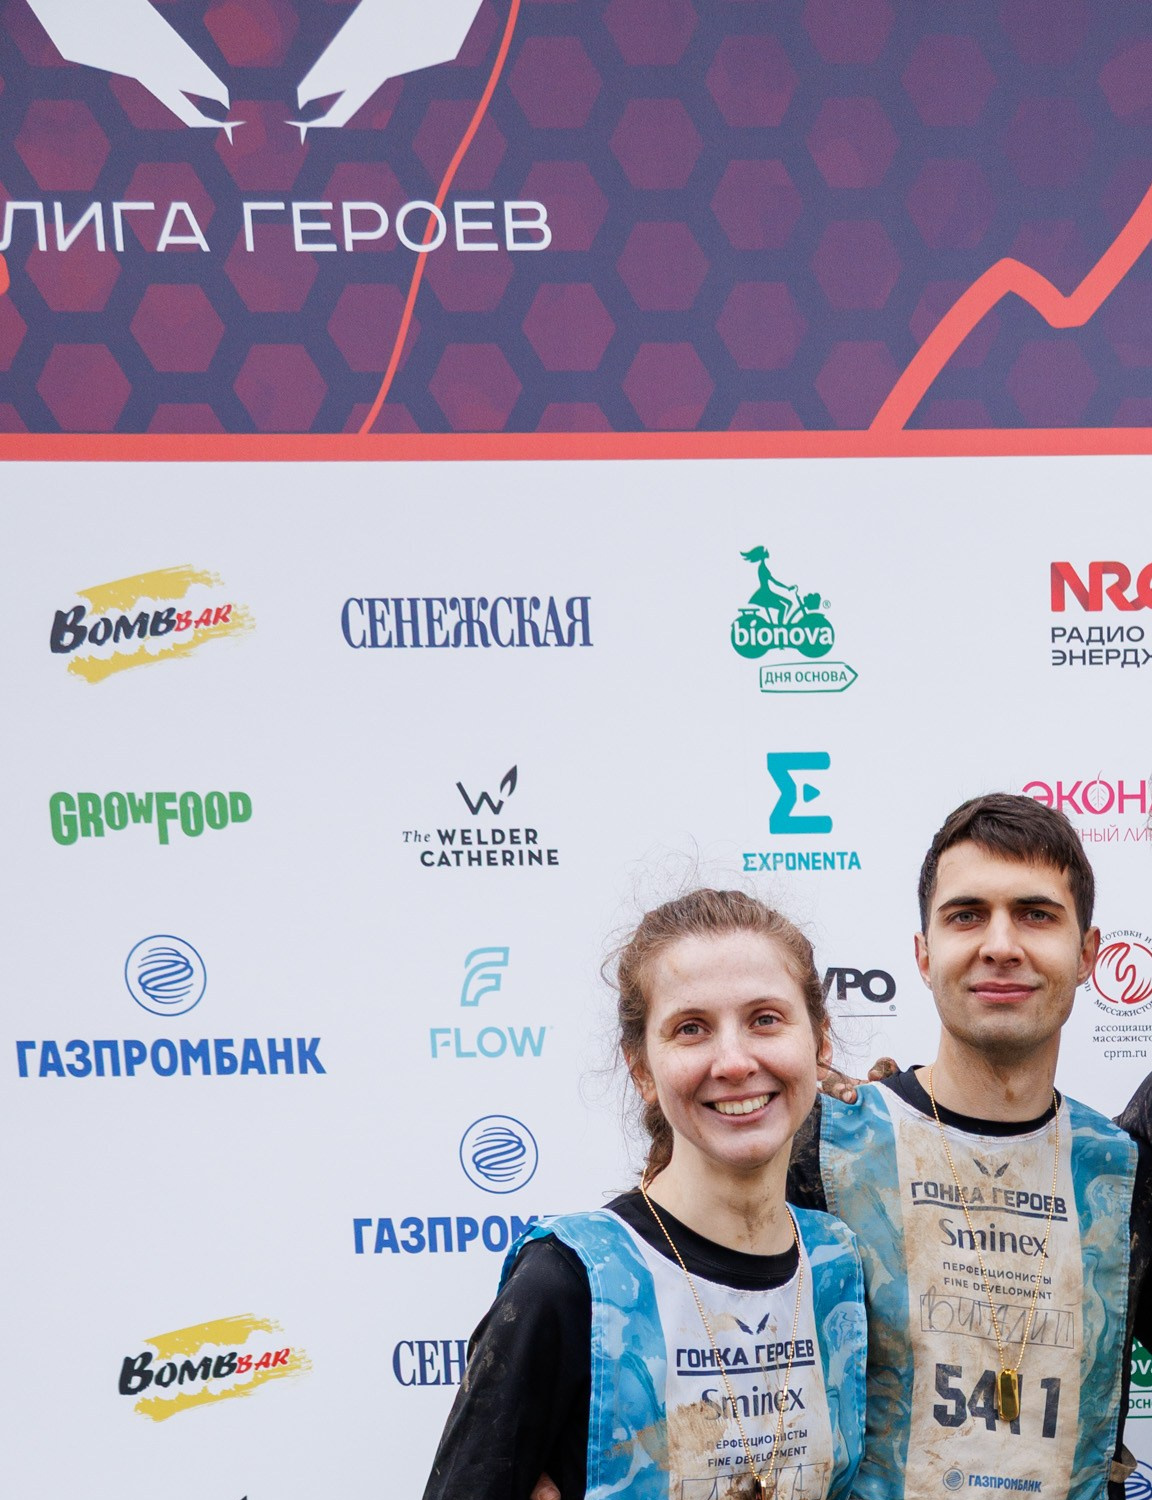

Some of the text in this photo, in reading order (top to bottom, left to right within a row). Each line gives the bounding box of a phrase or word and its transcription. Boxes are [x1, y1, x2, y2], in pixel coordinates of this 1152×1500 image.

[0, 200, 552, 253] ЛИГА ГЕРОЕВ
[341, 596, 594, 649] СЕНЕЖСКАЯ
[733, 620, 833, 646] bionova
[1051, 626, 1145, 645] РАДИО
[765, 671, 847, 684] ДНЯ ОСНОВА
[49, 791, 252, 846] GROWFOOD
[402, 828, 539, 845] The WELDER
[420, 849, 559, 867] CATHERINE
[430, 1026, 546, 1058] FLOW
[1104, 1049, 1147, 1060] cprm.ru
[16, 1037, 327, 1078] ГАЗПРОМБАНК
[911, 1182, 1067, 1214] ГОНКА ГЕРОЕВ
[353, 1215, 567, 1254] ГАЗПРОМ
[939, 1218, 1049, 1259] Sminex
[943, 1262, 1052, 1285] ПЕРФЕКЦИОНИСТЫ
[944, 1277, 1052, 1300] FINE DEVELOPMENT
[676, 1339, 815, 1368] ГОНКА ГЕРОЕВ
[701, 1386, 806, 1420] Sminex
[708, 1446, 808, 1468] FINE DEVELOPMENT
[968, 1475, 1042, 1493] ГАЗПРОМБАНК
